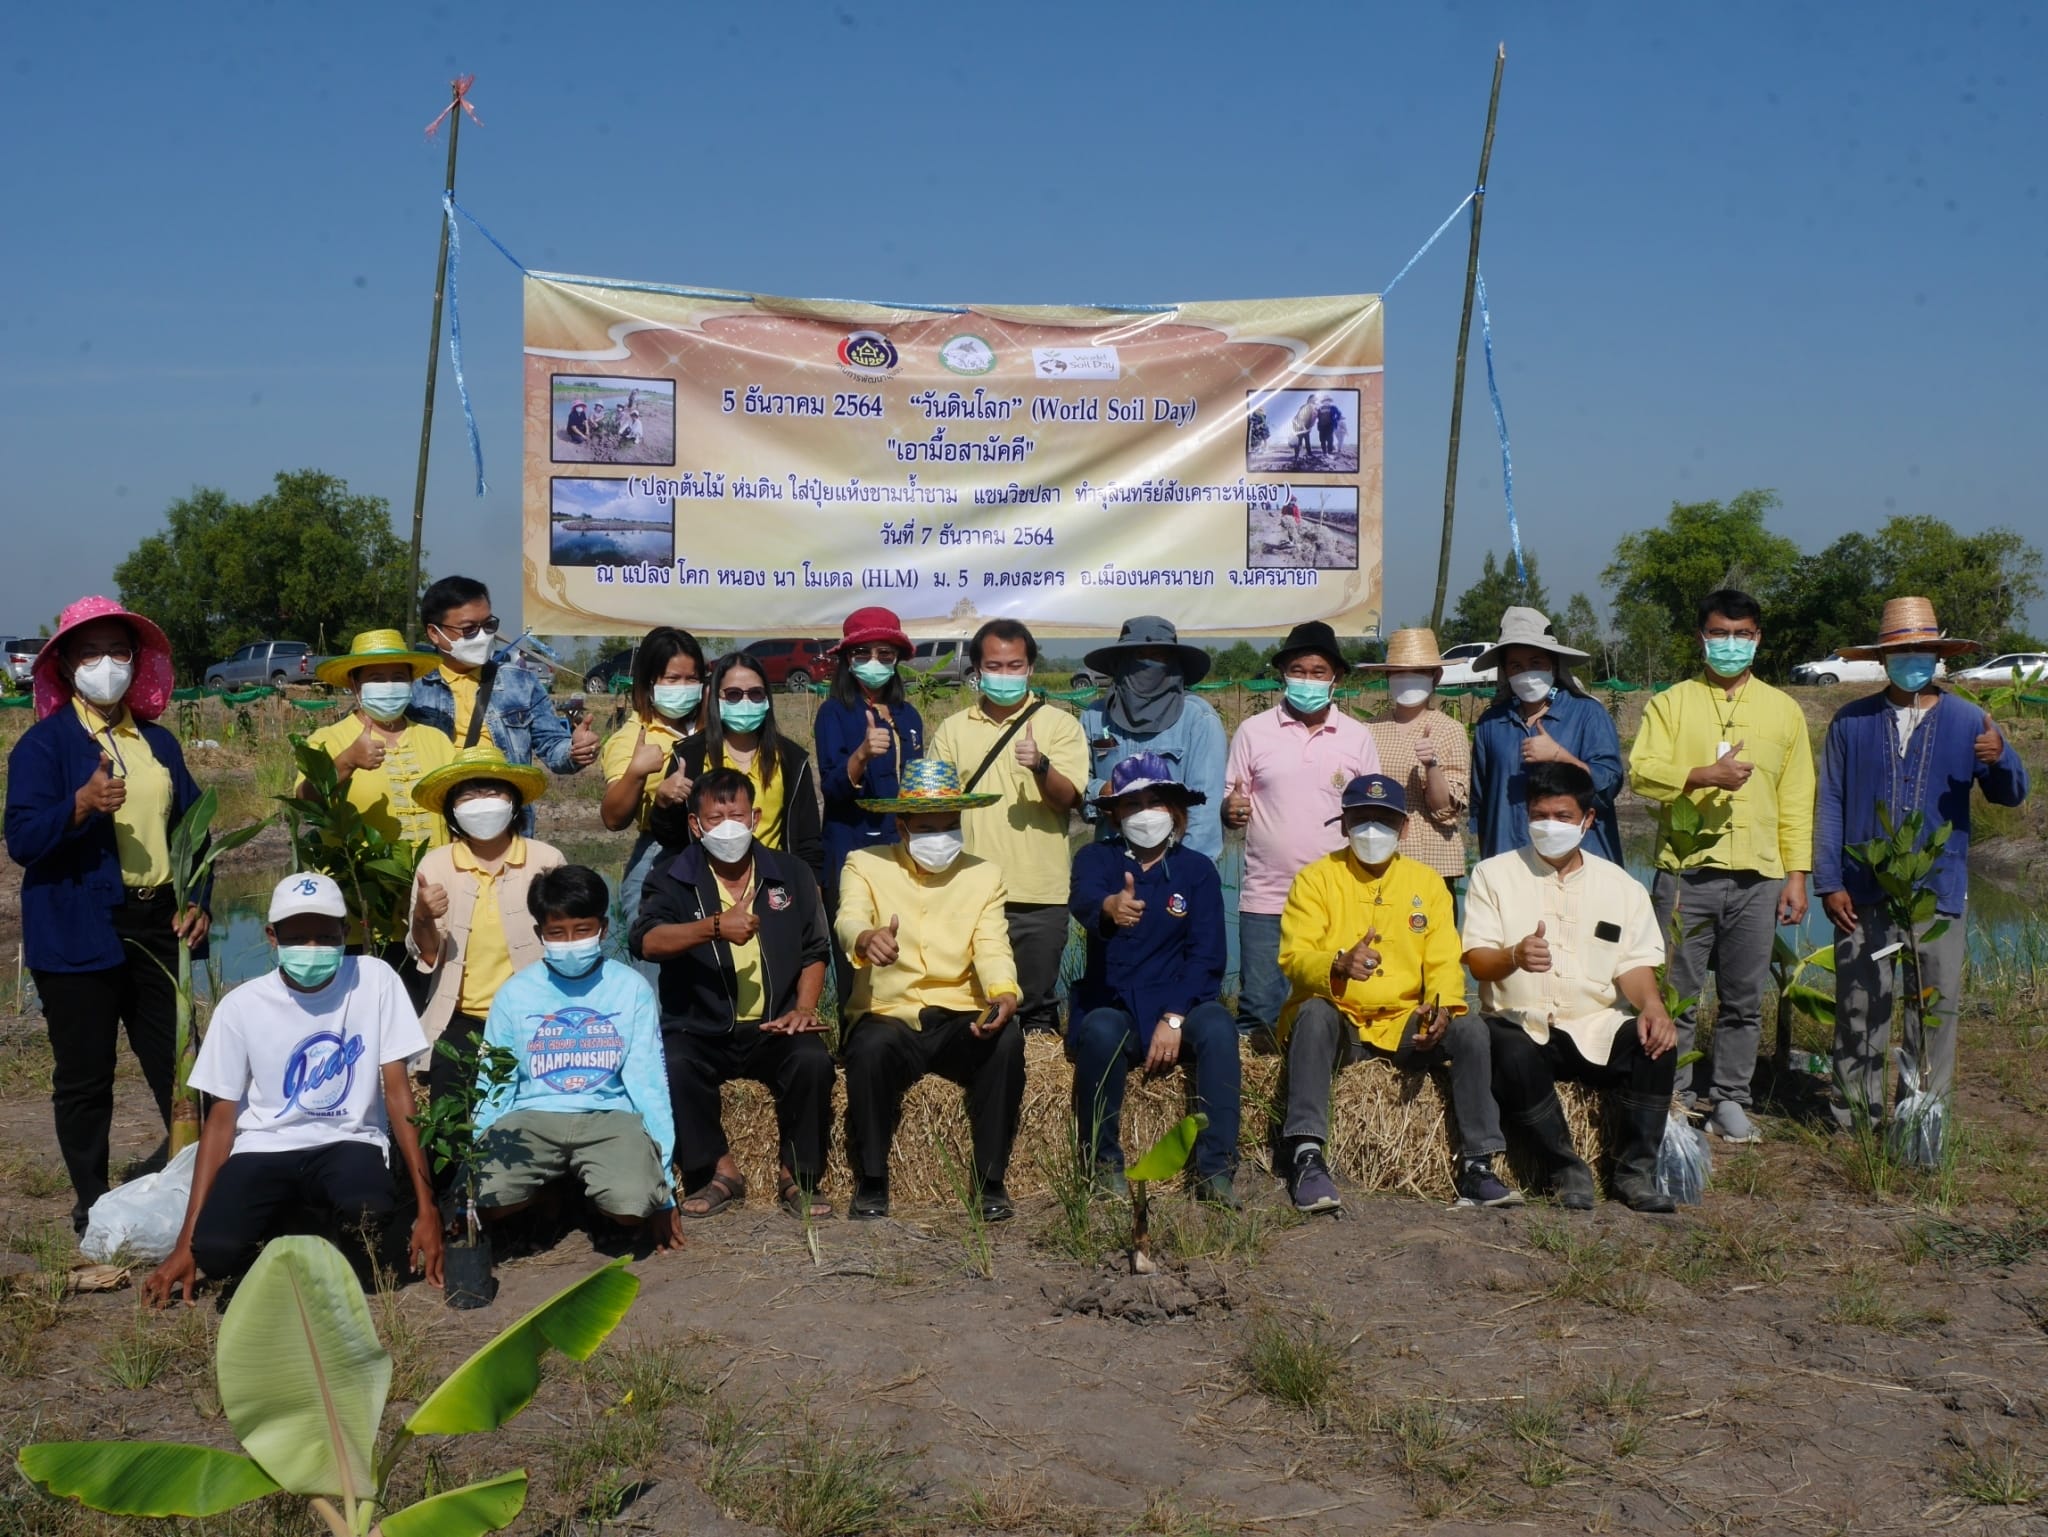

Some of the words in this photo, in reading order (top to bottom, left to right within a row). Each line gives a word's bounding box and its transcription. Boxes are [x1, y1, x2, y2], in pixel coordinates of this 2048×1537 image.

[1070, 361, 1090, 369] Soil
[1093, 360, 1115, 372] Day
[722, 390, 735, 412] 5
[745, 385, 824, 415] ธันวาคม
[834, 395, 883, 417] 2564
[1032, 398, 1098, 422] (World
[1107, 398, 1144, 421] Soil
[1154, 399, 1196, 426] Day)
[888, 427, 1034, 462] "เอามื้อสามัคคี"
[732, 477, 782, 499] ห่มดิน
[974, 483, 1060, 504] แซนวิชปลา
[880, 519, 914, 545] วันที่
[921, 527, 932, 545] 7
[939, 523, 1005, 546] ธันวาคม
[1013, 527, 1054, 546] 2564
[597, 565, 613, 583] ณ
[623, 563, 670, 585] แปลง
[677, 559, 709, 586] โคก
[717, 568, 765, 587] หนอง
[773, 570, 795, 587] นา
[803, 561, 853, 588] โมเดล
[862, 568, 919, 589] (HLM)
[958, 570, 969, 588] 5
[983, 569, 1065, 588] ต.ดงละคร
[1080, 563, 1214, 587] อ.เมืองนครนายก
[1228, 566, 1318, 587] จ.นครนายก
[538, 1027, 564, 1037] 2017
[587, 1024, 614, 1035] ESSZ
[549, 1039, 577, 1050] GROUP
